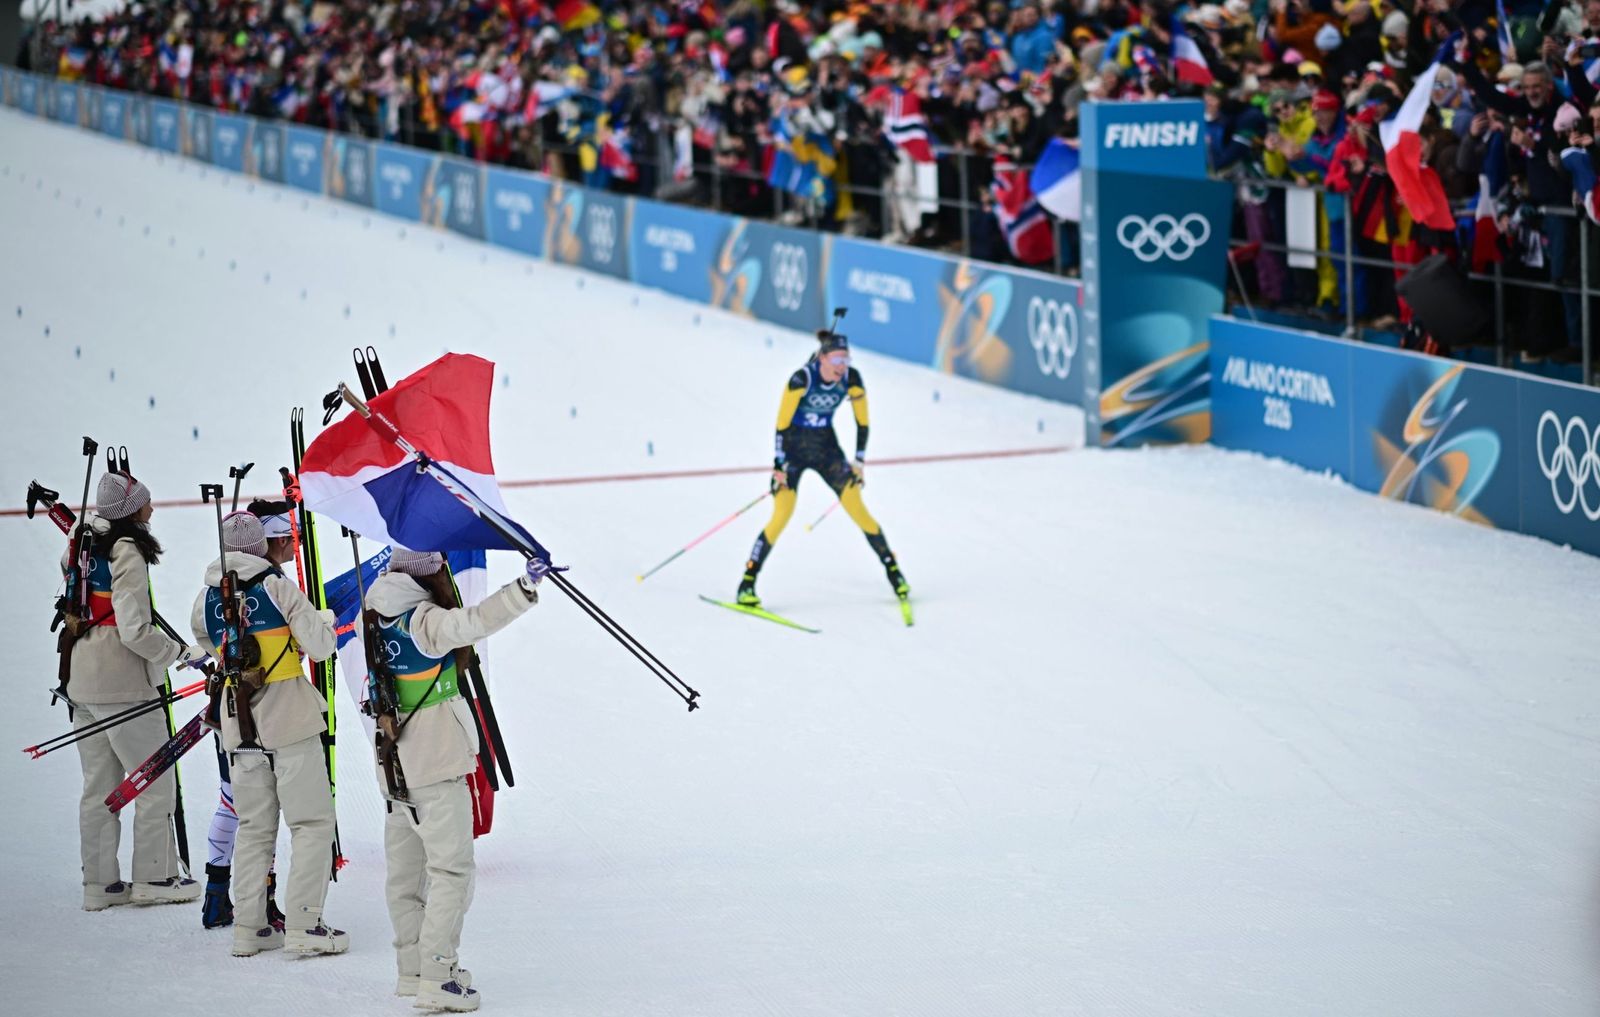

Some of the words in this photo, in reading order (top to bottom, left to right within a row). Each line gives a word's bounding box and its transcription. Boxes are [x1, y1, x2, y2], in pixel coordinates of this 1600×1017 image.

[1104, 120, 1199, 149] FINISH
[1221, 355, 1275, 394] MILANO
[1276, 365, 1336, 409] CORTINA
